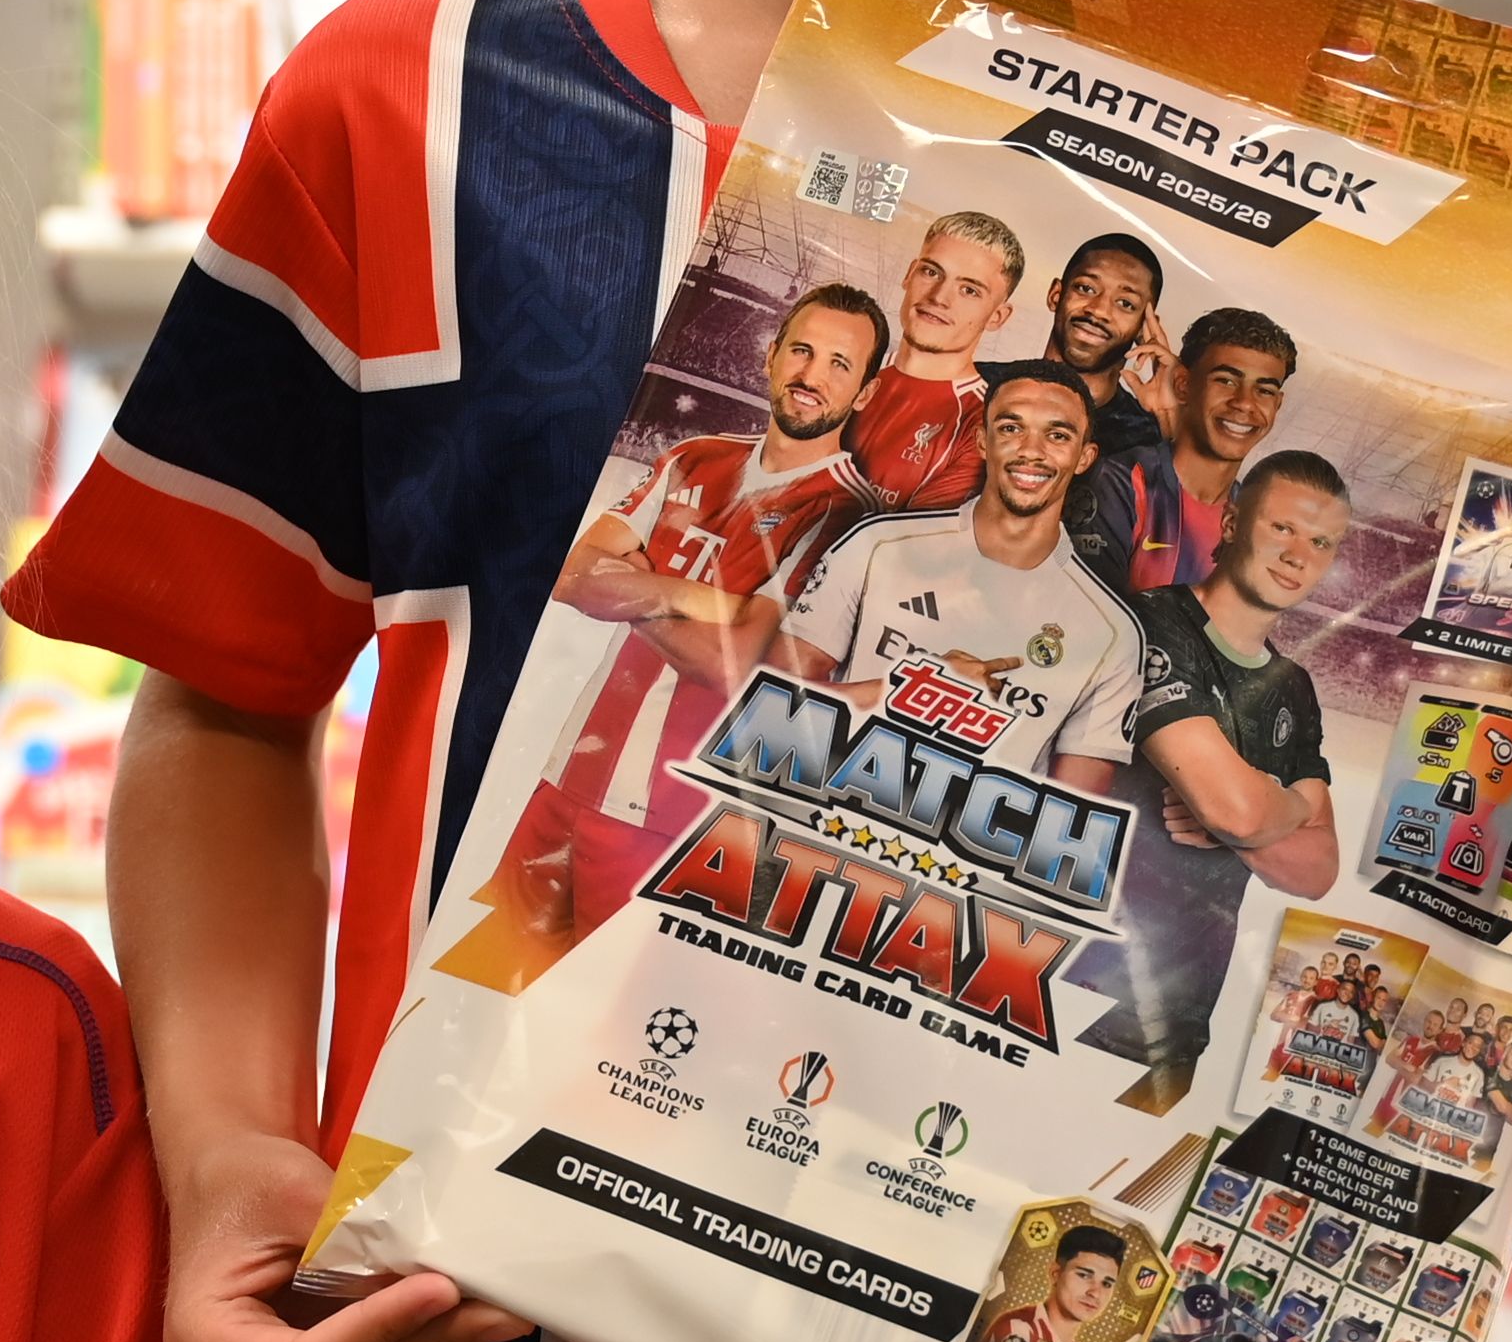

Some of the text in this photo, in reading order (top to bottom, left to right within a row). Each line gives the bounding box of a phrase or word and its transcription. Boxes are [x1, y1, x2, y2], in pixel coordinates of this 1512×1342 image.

[986, 46, 1377, 215] STARTER PACK
[1045, 127, 1273, 232] SEASON 2025/26
[1438, 630, 1450, 642] 2
[711, 680, 1121, 901] MATCH
[1401, 829, 1426, 844] VAR
[655, 808, 1071, 1043] ATTAX
[1417, 889, 1457, 919] TACTIC
[1457, 910, 1493, 935] CARD
[657, 911, 1032, 1069] TRADING CARD GAME
[638, 1058, 678, 1082] UEFA
[1290, 1031, 1367, 1070] MATCH
[597, 1060, 706, 1113] CHAMPIONS
[1280, 1057, 1358, 1097] ATTAX
[608, 1082, 681, 1120] LEAGUE
[772, 1108, 811, 1130] UEFA
[745, 1116, 822, 1157] EUROPA
[746, 1136, 811, 1168] LEAGUE
[1309, 1129, 1317, 1141] 1
[1327, 1136, 1365, 1163] GAME
[1367, 1154, 1411, 1180] GUIDE
[865, 1161, 977, 1214] CONFERENCE
[908, 1158, 948, 1180] UEFA
[1295, 1155, 1380, 1201] CHECKLIST
[1381, 1193, 1419, 1214] AND
[1314, 1148, 1323, 1160] 1
[1335, 1155, 1396, 1190] BINDER
[882, 1186, 946, 1219] LEAGUE
[1291, 1170, 1300, 1183] 1
[1313, 1179, 1351, 1206] PLAY
[1352, 1197, 1401, 1224] PITCH
[556, 1155, 934, 1317] OFFICIAL TRADING CARDS
